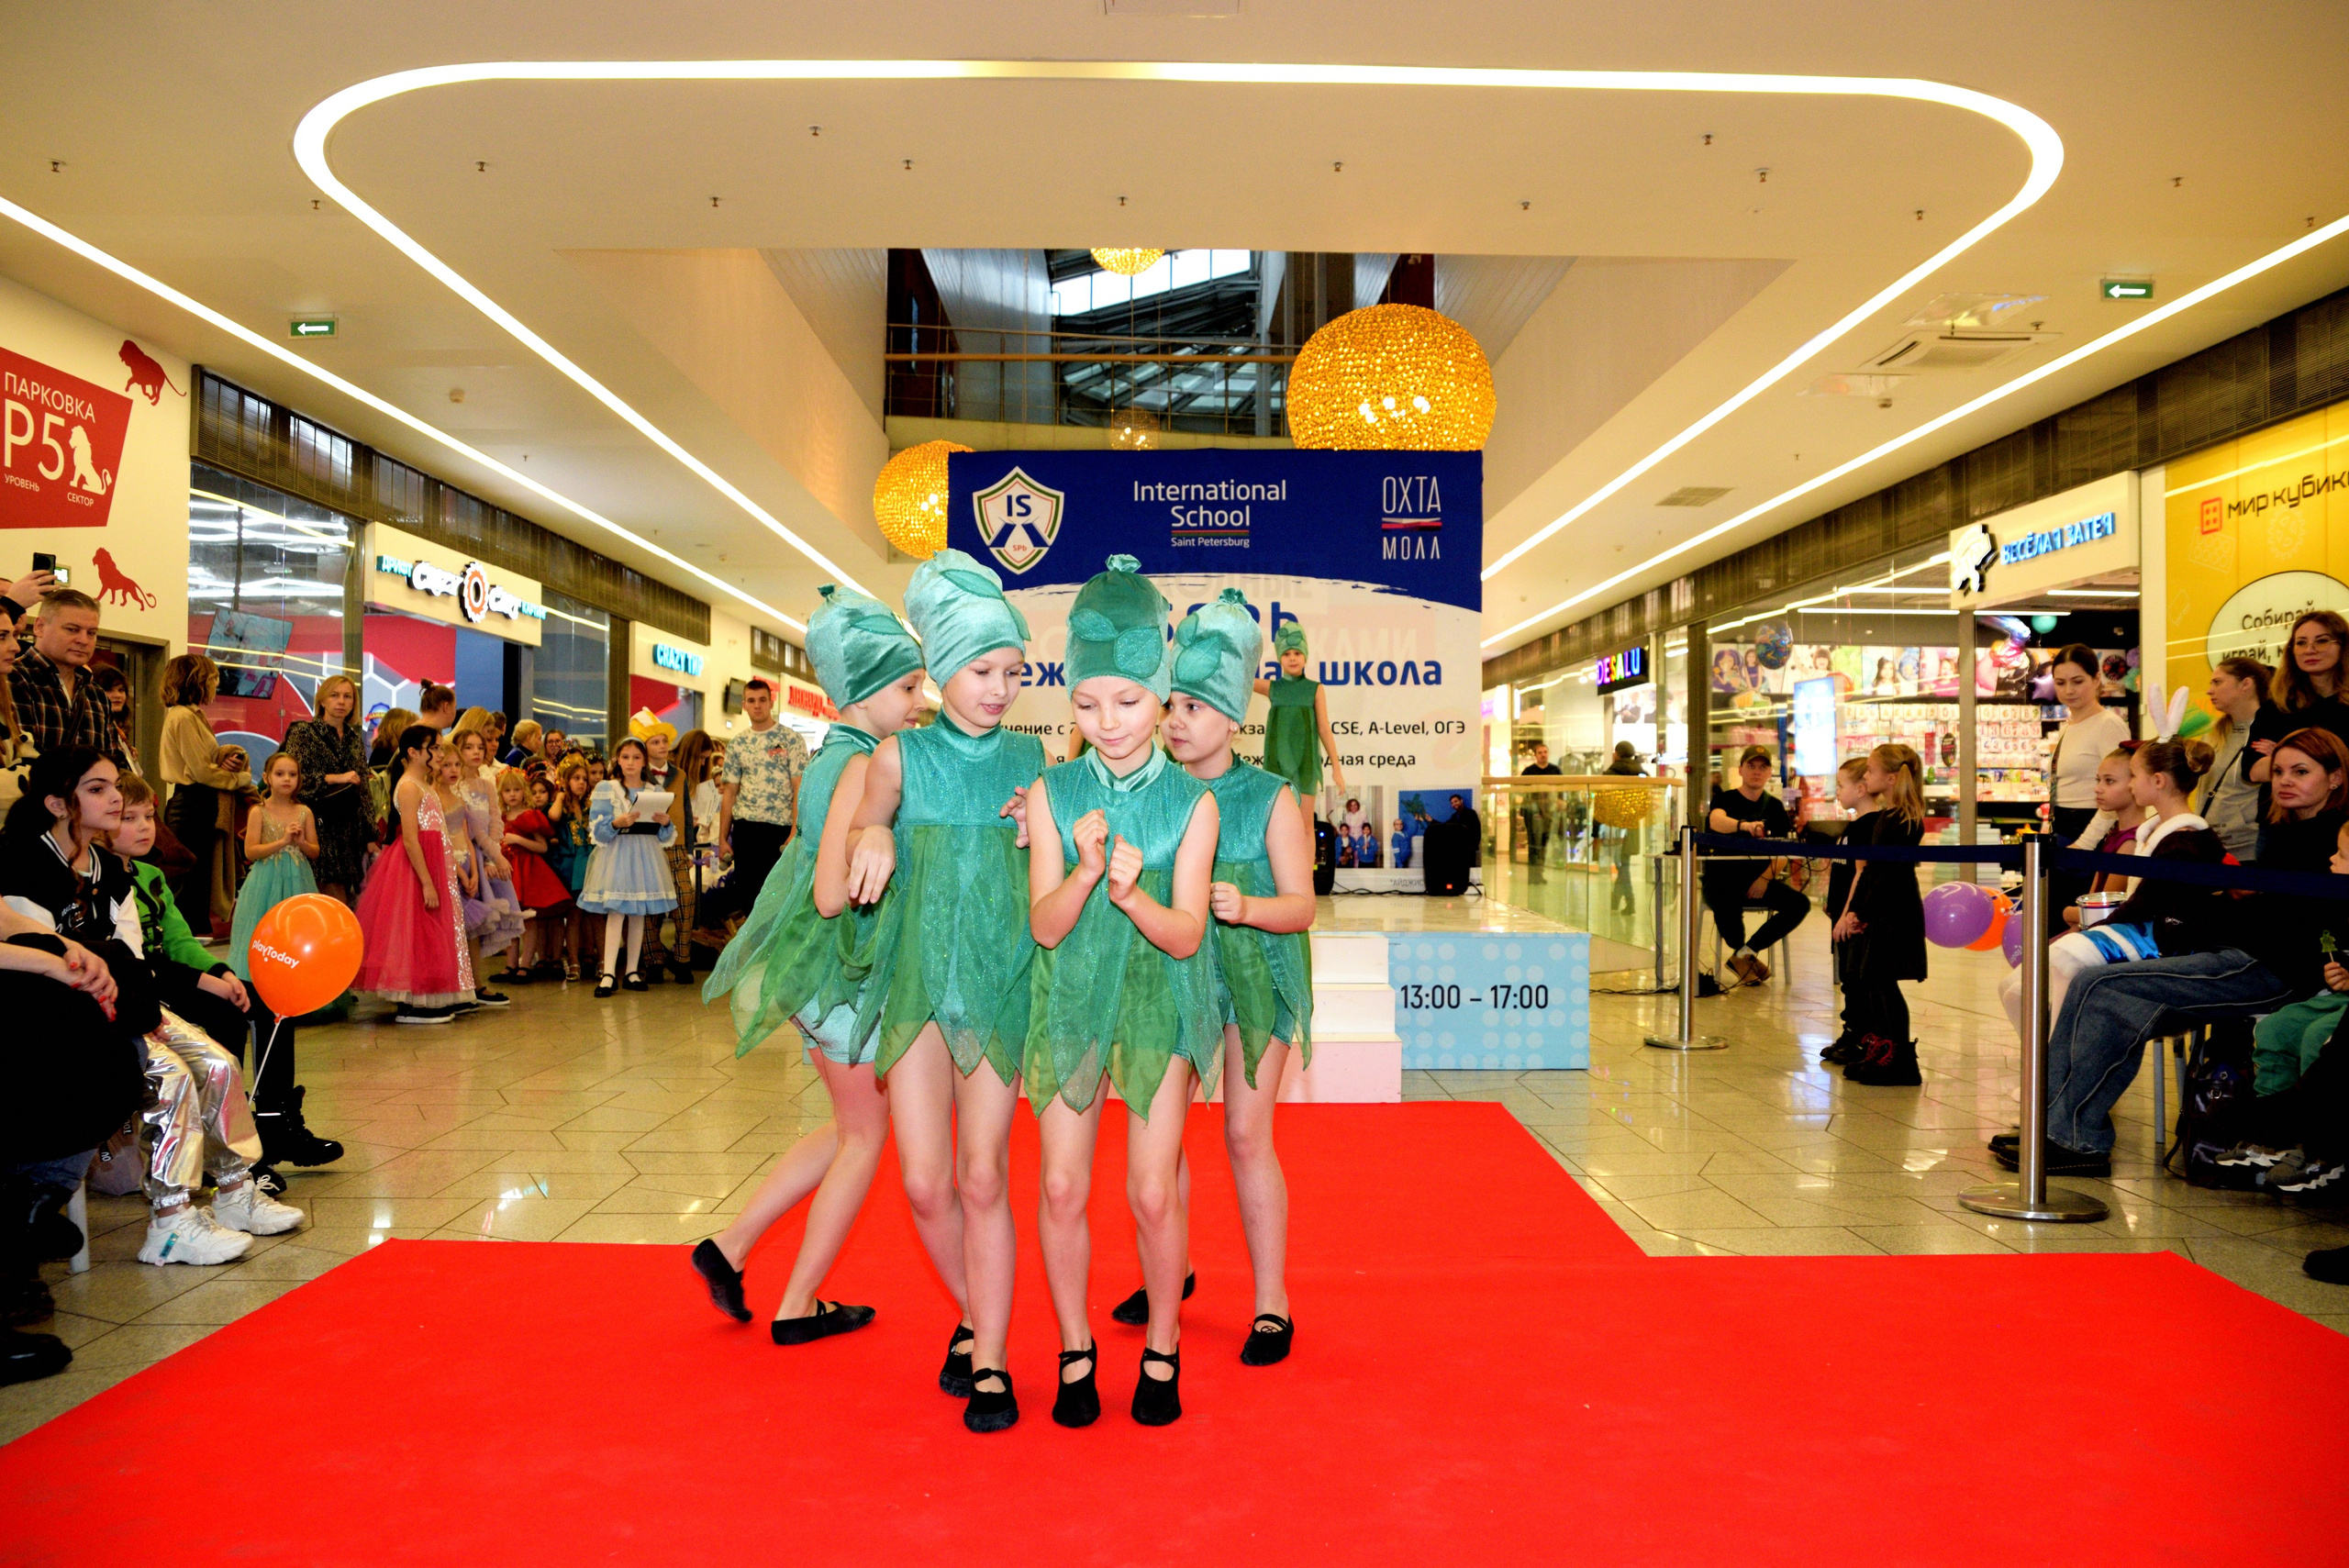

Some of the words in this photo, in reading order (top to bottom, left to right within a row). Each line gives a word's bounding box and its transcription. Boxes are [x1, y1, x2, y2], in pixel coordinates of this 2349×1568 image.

[5, 372, 95, 423] ПАРКОВКА
[5, 473, 39, 492] УРОВЕНЬ
[1134, 479, 1286, 501] International
[1383, 475, 1442, 514] ОХТА
[2228, 494, 2269, 518] мир
[2273, 471, 2349, 508] кубик
[67, 492, 95, 506] СЕКТОР
[1007, 494, 1031, 517] IS
[1171, 505, 1250, 527] School
[1171, 538, 1196, 547] Saint
[1197, 537, 1250, 548] Petersburg
[1383, 536, 1441, 560] МОЛЛ
[2000, 531, 2063, 565] ВЕСЁЛАЯ
[2065, 511, 2115, 548] ЗАТЕЯ
[654, 642, 688, 672] CRAZY
[1595, 646, 1641, 686] DESALU
[1319, 660, 1442, 685] школа
[1057, 725, 1064, 735] с
[1331, 721, 1364, 736] CSE,
[1368, 720, 1429, 736] A-Level,
[1434, 720, 1465, 734] ОГЭ
[1369, 755, 1416, 768] среда
[251, 939, 300, 969] playToday
[1400, 984, 1461, 1009] 13:00
[1490, 984, 1549, 1009] 17:00
